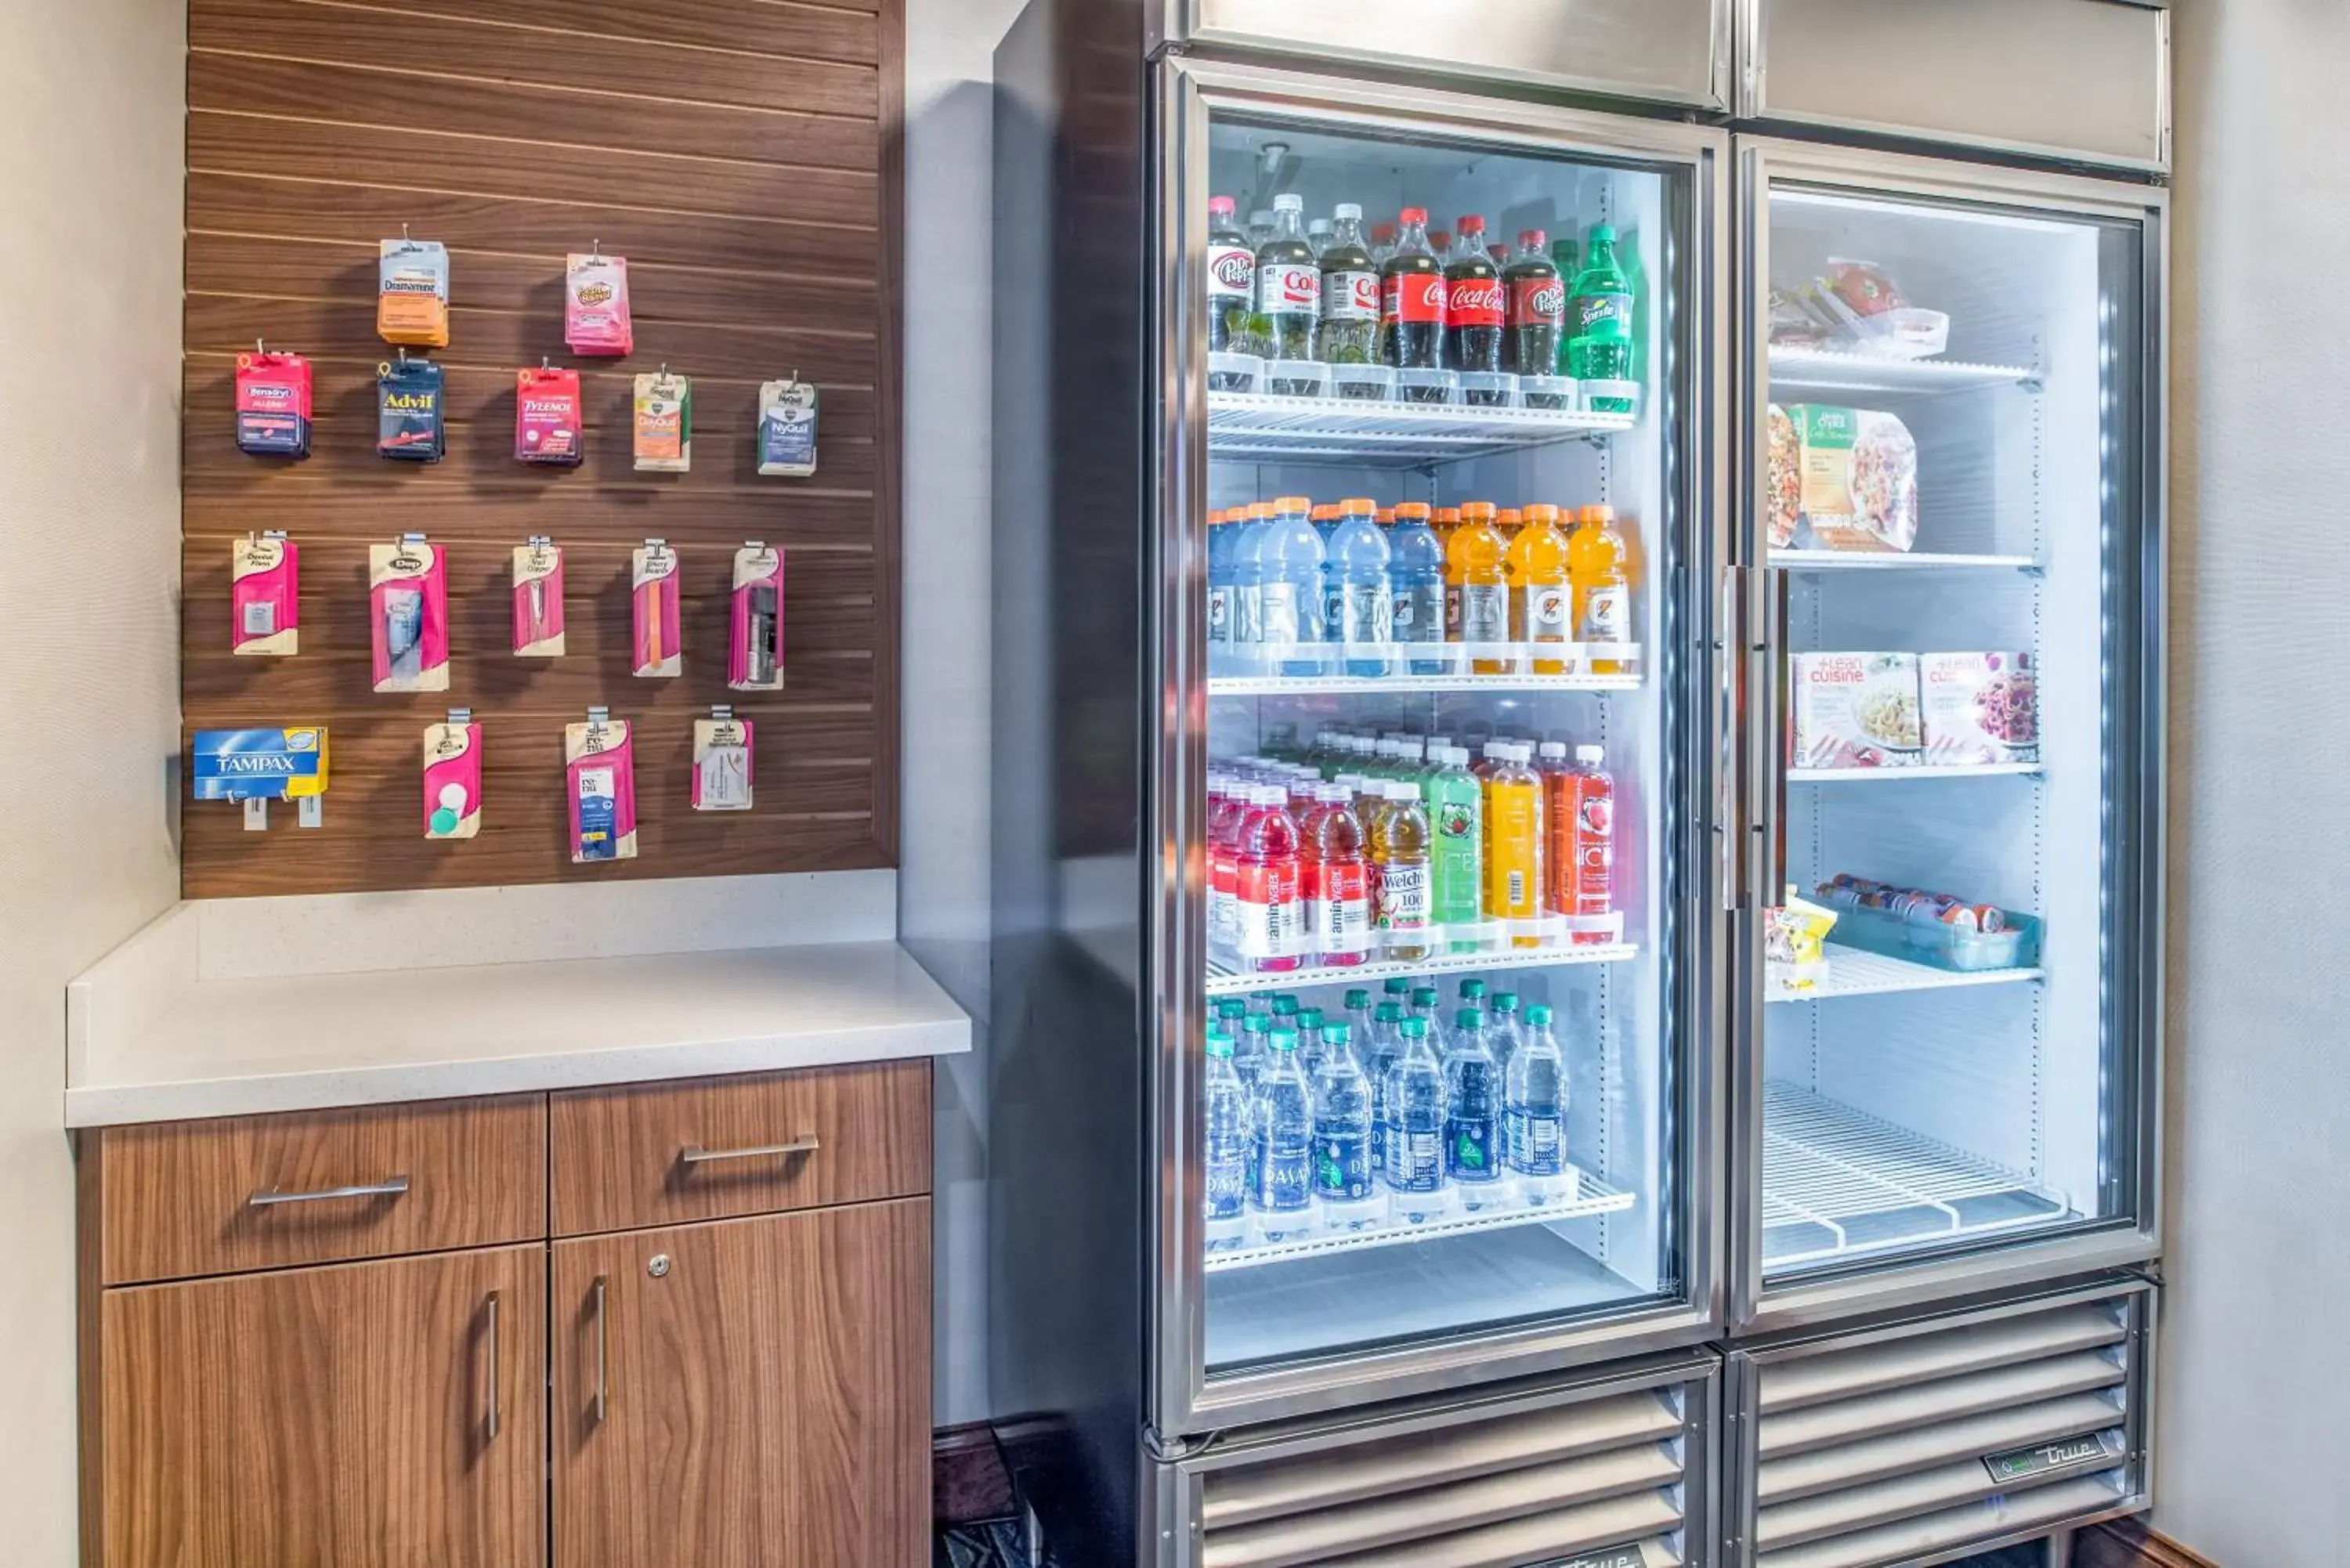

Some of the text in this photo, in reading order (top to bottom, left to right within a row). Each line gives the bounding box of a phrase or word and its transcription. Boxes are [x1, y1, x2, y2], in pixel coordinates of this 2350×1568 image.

[384, 393, 433, 408] Advil
[772, 423, 808, 434] NyQuil
[1810, 670, 1865, 683] cuisine
[216, 755, 295, 773] TAMPAX
[2035, 1443, 2097, 1464] True
